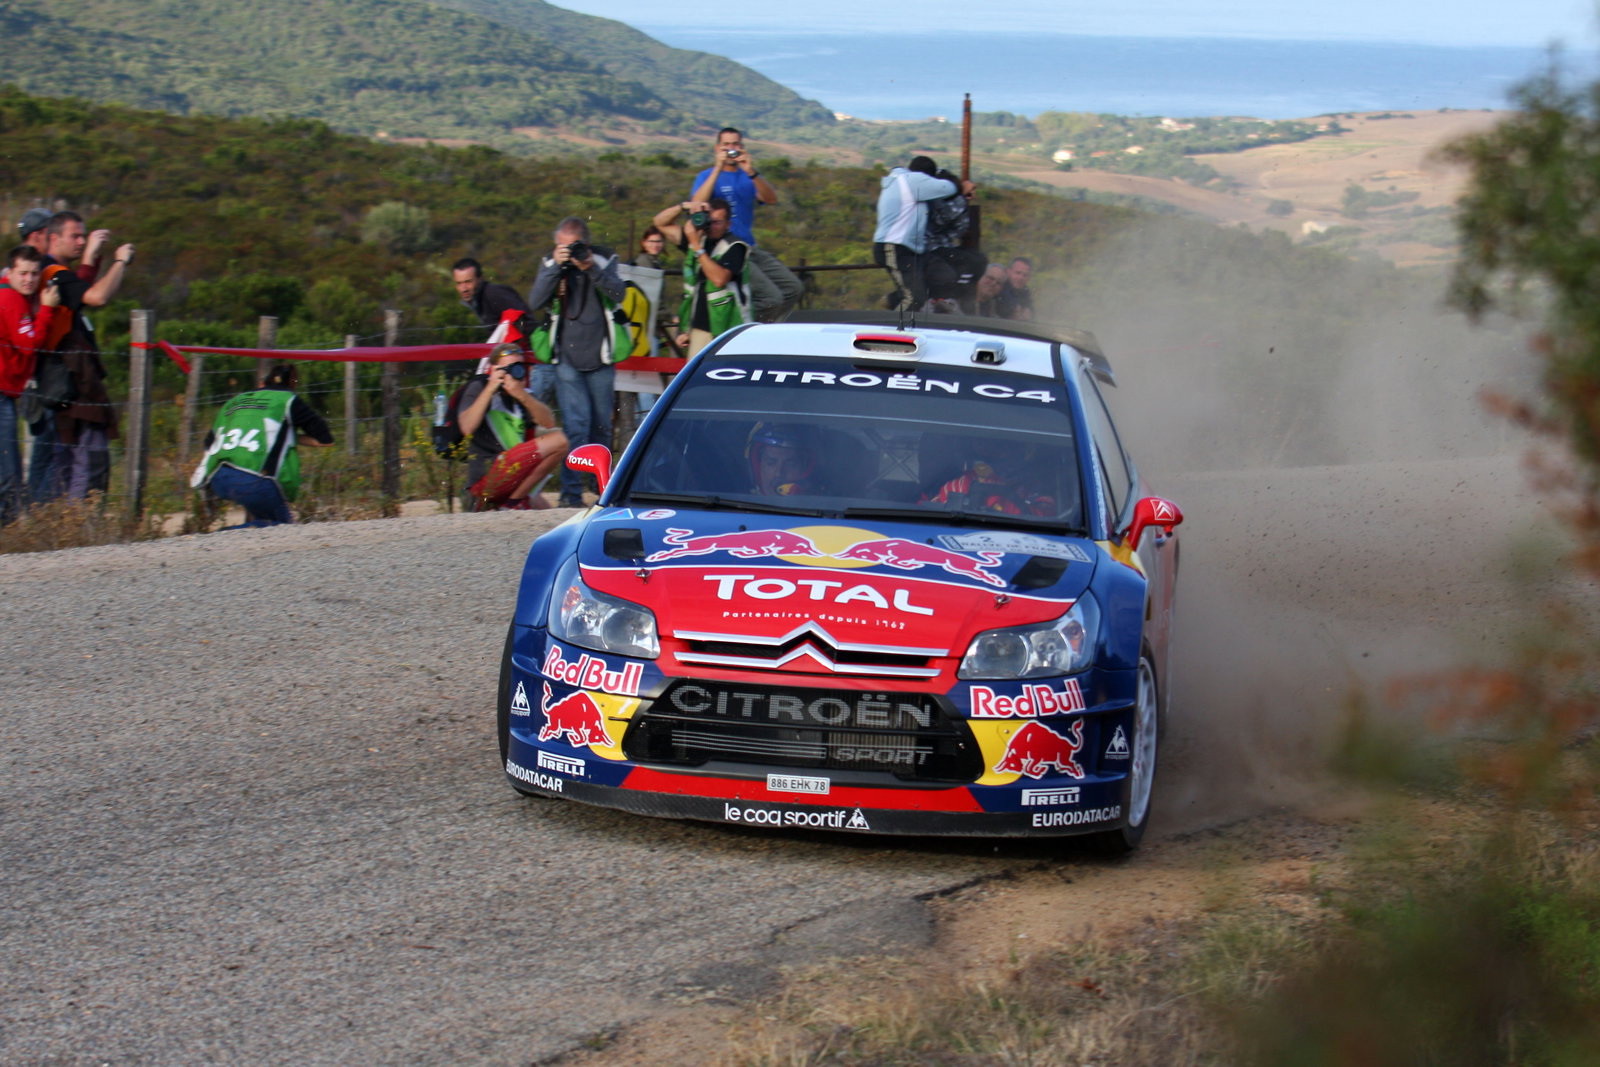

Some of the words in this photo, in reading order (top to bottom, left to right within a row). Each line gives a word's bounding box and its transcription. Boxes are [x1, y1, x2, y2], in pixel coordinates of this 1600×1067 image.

[706, 368, 959, 394] CITROËN
[973, 384, 1056, 404] C4
[568, 455, 595, 467] TOTAL
[703, 574, 934, 616] TOTAL
[819, 613, 867, 624] depuis
[541, 644, 589, 688] Red
[580, 656, 645, 697] Bull
[670, 684, 932, 728] CITROËN
[970, 684, 1037, 718] Red
[1033, 677, 1086, 717] Bull
[537, 750, 586, 776] PIRELLI
[836, 746, 933, 765] SPORT
[506, 758, 563, 793] EURODATACAR
[771, 778, 788, 789] 886
[790, 780, 811, 790] EHK
[814, 781, 826, 791] 78
[1020, 786, 1080, 806] PIRELLI
[725, 802, 741, 821] le
[743, 810, 781, 826] coq
[783, 810, 847, 828] sportif
[1032, 805, 1121, 828] EURODATACAR
